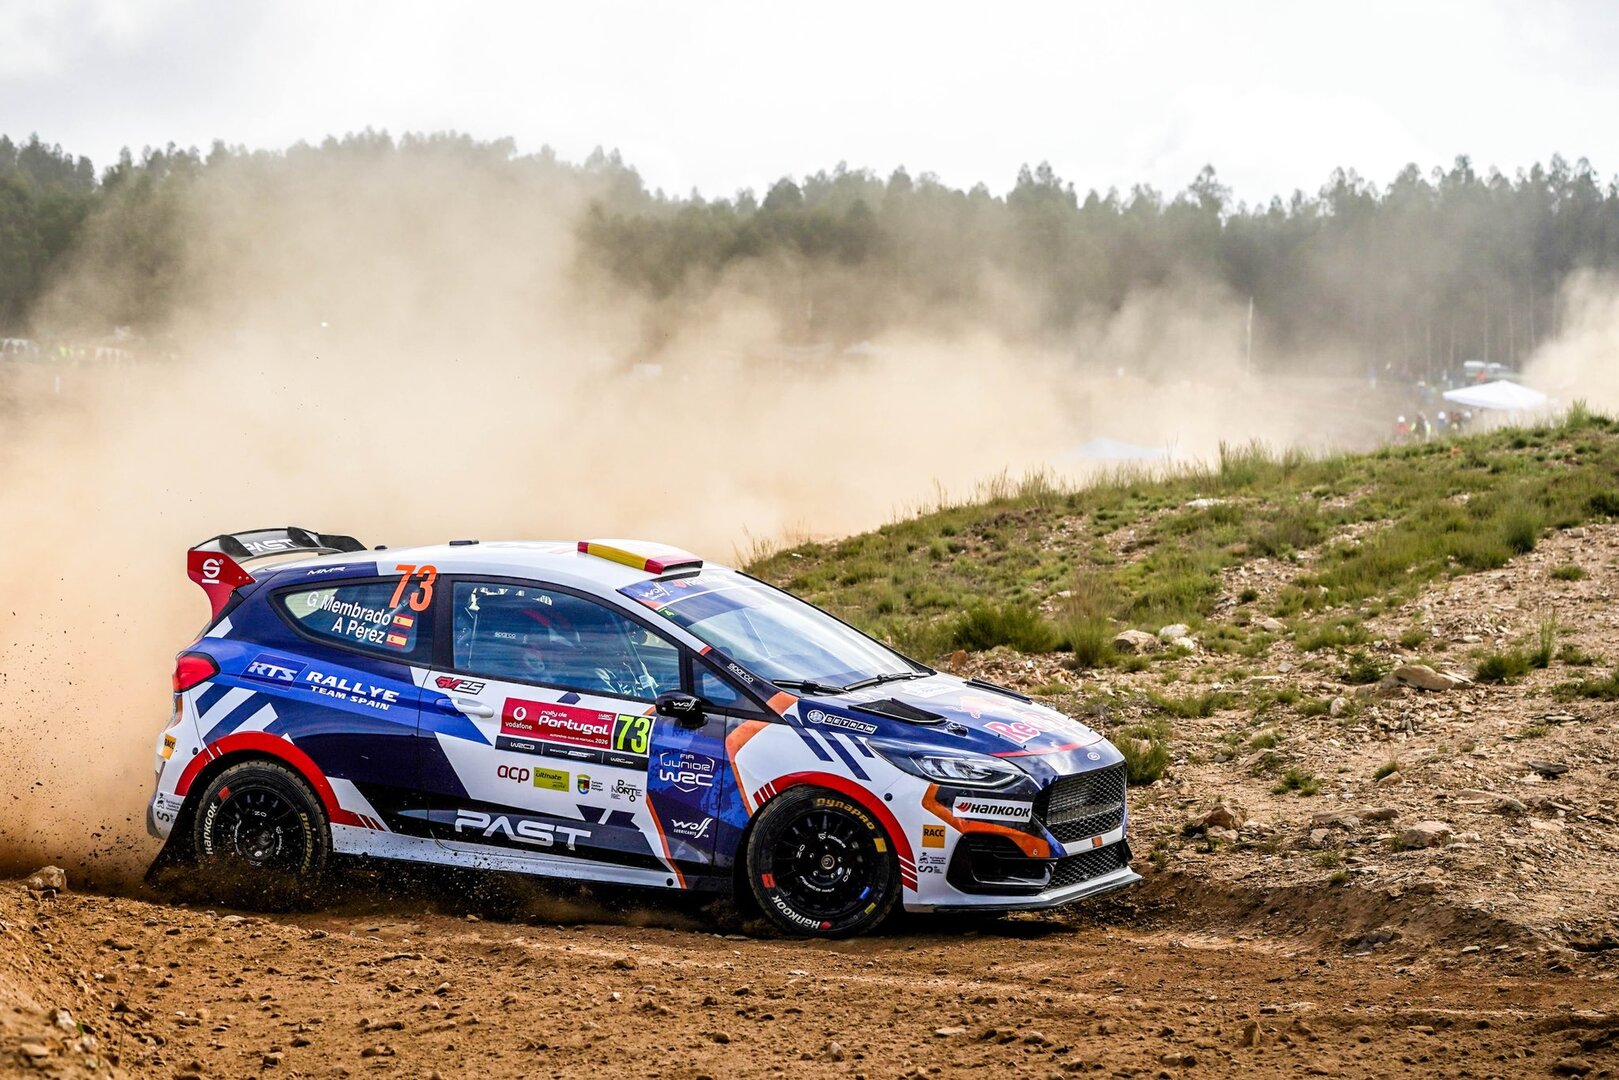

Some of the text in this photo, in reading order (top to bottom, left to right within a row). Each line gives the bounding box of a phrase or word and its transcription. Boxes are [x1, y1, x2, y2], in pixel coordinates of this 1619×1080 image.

[389, 564, 437, 612] 73
[307, 591, 391, 626] G Membrado
[331, 616, 386, 644] A Pérez
[247, 661, 298, 682] RTS
[306, 671, 400, 703] RALLYE
[310, 685, 390, 711] TEAM SPAIN
[541, 709, 558, 717] rally
[505, 720, 533, 731] vodafone
[538, 715, 609, 735] Portugal
[617, 714, 650, 754] 73
[826, 715, 875, 733] SETRAM
[497, 765, 530, 783] acp
[663, 760, 711, 772] JUNIOR
[659, 769, 714, 787] WRC
[455, 809, 592, 851] PAST
[671, 817, 713, 839] wolf
[923, 828, 945, 837] RACC
